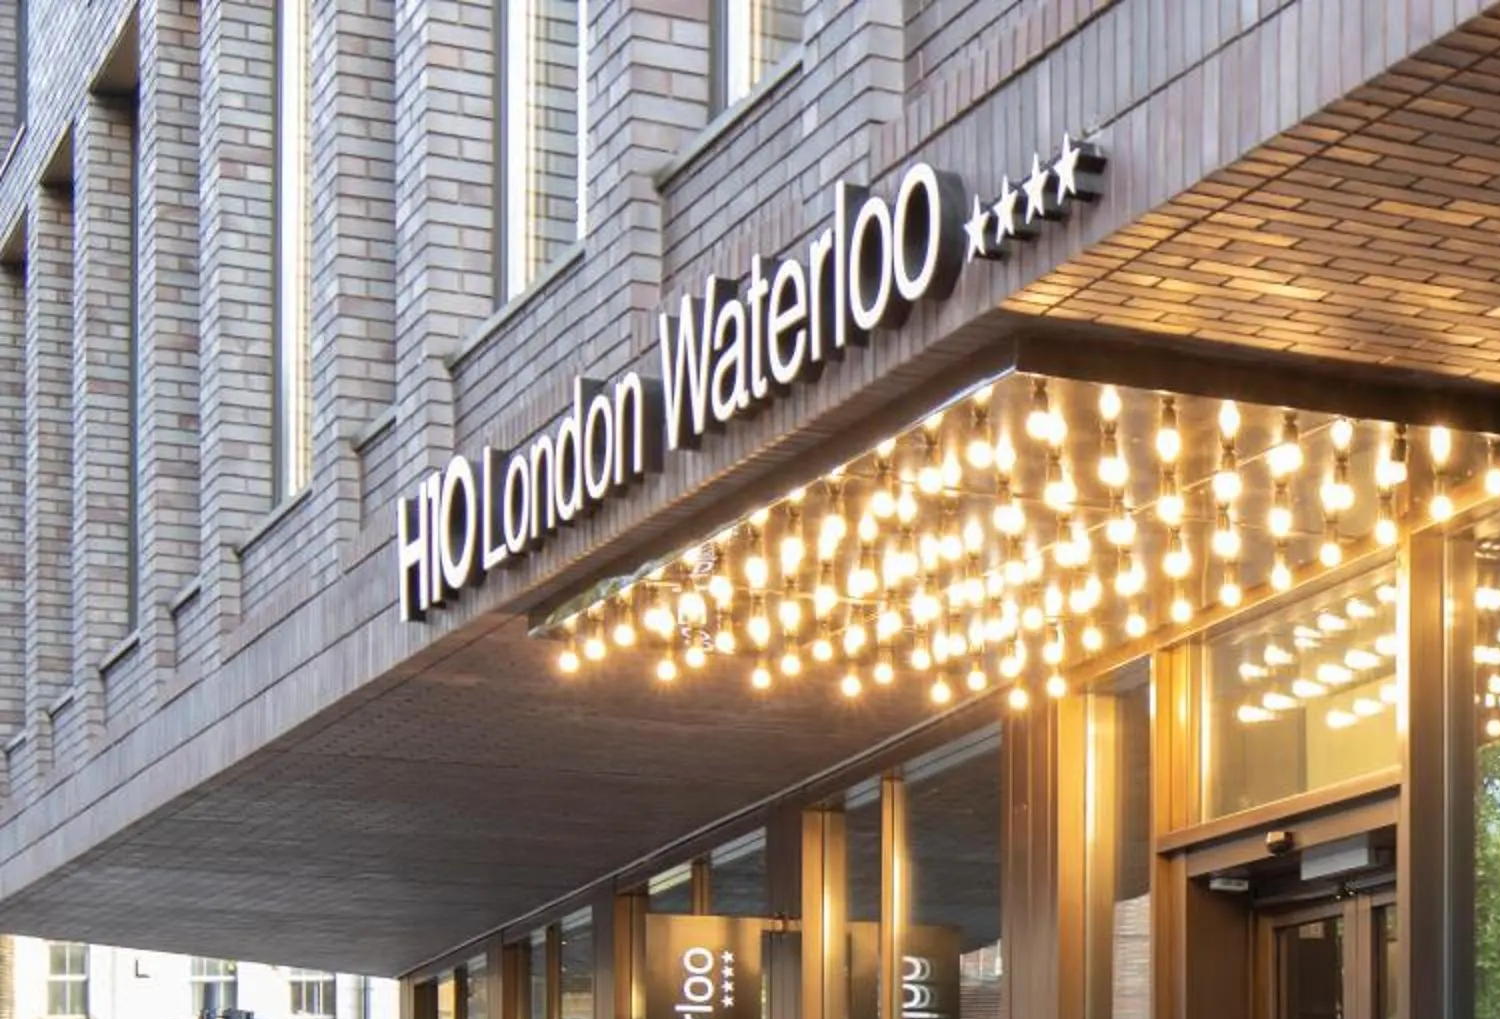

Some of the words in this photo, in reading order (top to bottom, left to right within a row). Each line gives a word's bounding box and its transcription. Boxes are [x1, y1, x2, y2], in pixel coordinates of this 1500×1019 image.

[396, 454, 476, 623] H10
[482, 371, 643, 571] London
[658, 161, 940, 452] Waterloo
